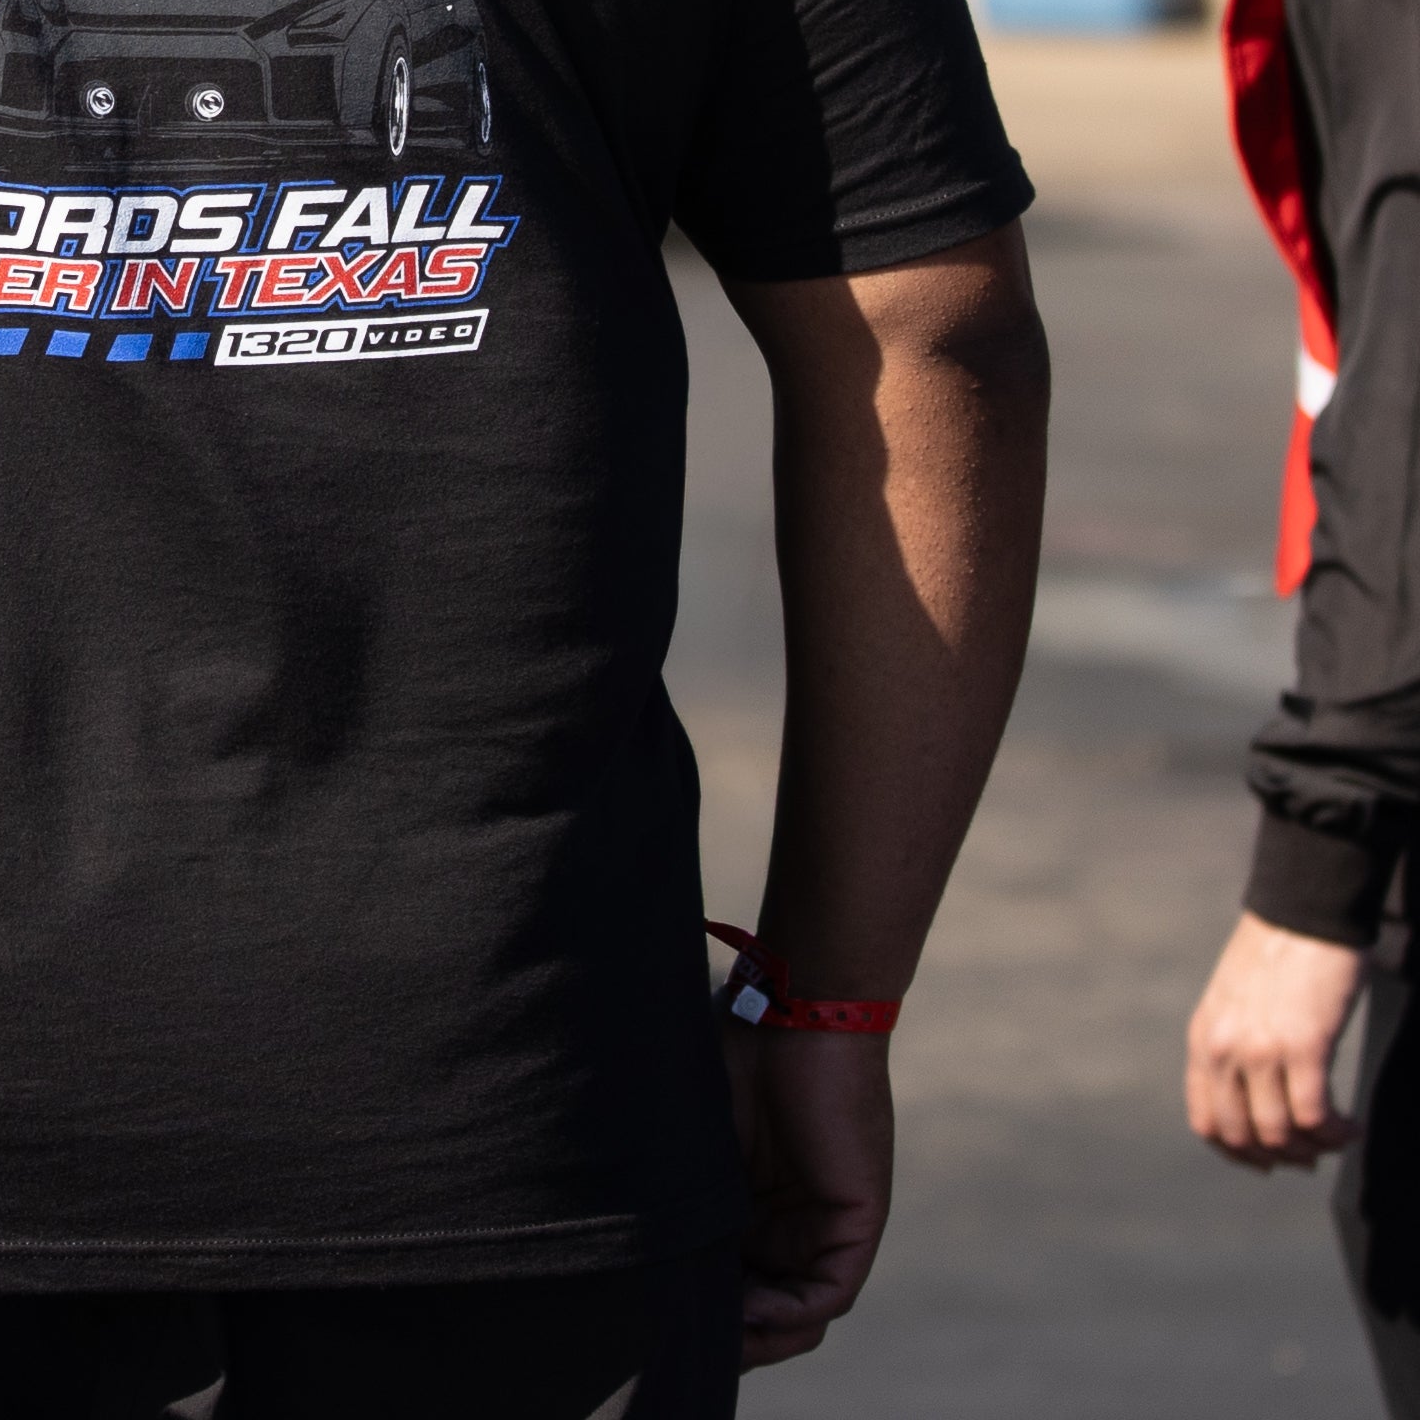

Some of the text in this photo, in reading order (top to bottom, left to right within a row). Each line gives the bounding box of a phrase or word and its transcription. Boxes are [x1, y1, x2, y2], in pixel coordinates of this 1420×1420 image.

[269, 182, 510, 252] FALL
[110, 256, 202, 313] IN
[215, 243, 489, 310] TEXAS
[227, 324, 473, 358] 1320 VIDEO
